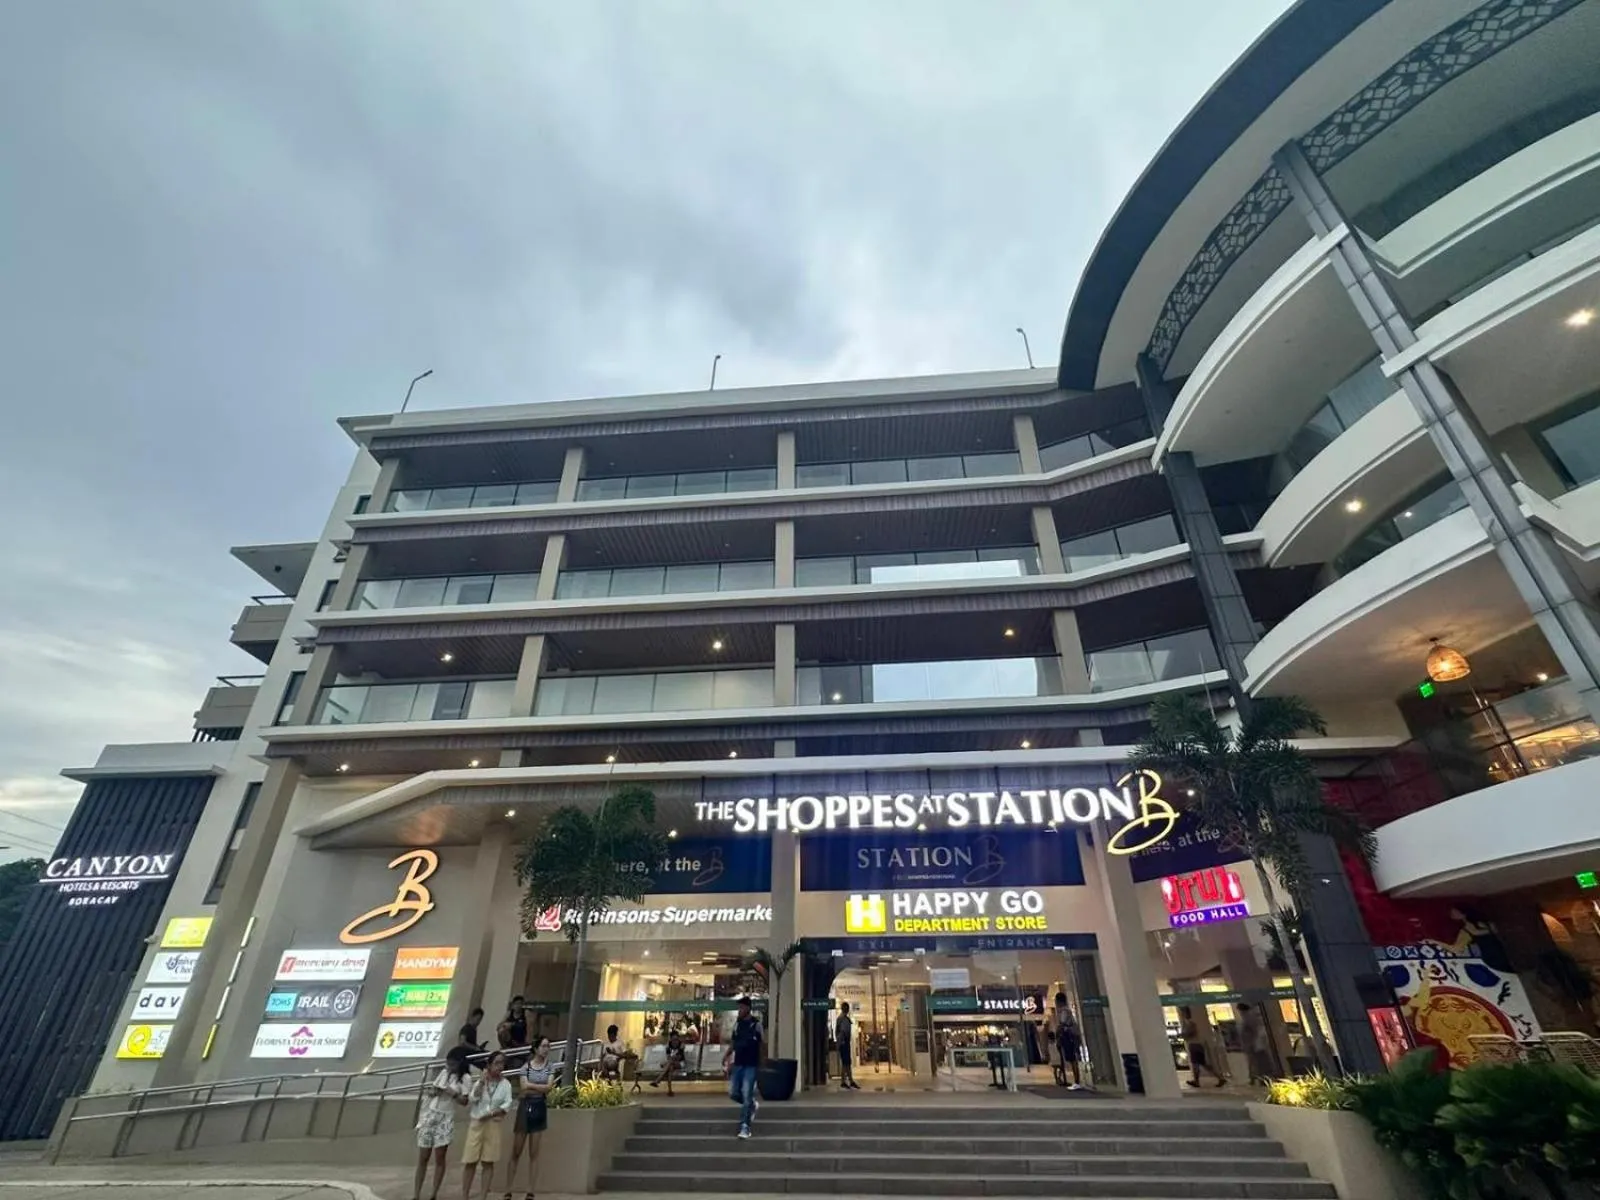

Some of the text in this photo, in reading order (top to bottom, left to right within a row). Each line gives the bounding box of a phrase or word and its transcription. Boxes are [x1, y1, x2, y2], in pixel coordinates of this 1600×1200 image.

[695, 768, 1181, 855] THE SHOPPES AT STATION B
[1178, 833, 1194, 847] at
[1195, 827, 1221, 843] the
[46, 854, 174, 877] CANYON
[675, 857, 701, 873] the
[857, 846, 973, 869] STATION
[892, 891, 988, 915] HAPPY
[1000, 890, 1043, 913] GO
[894, 916, 1047, 933] DEPARTMENT STORE
[1172, 907, 1243, 925] FOOD HALL
